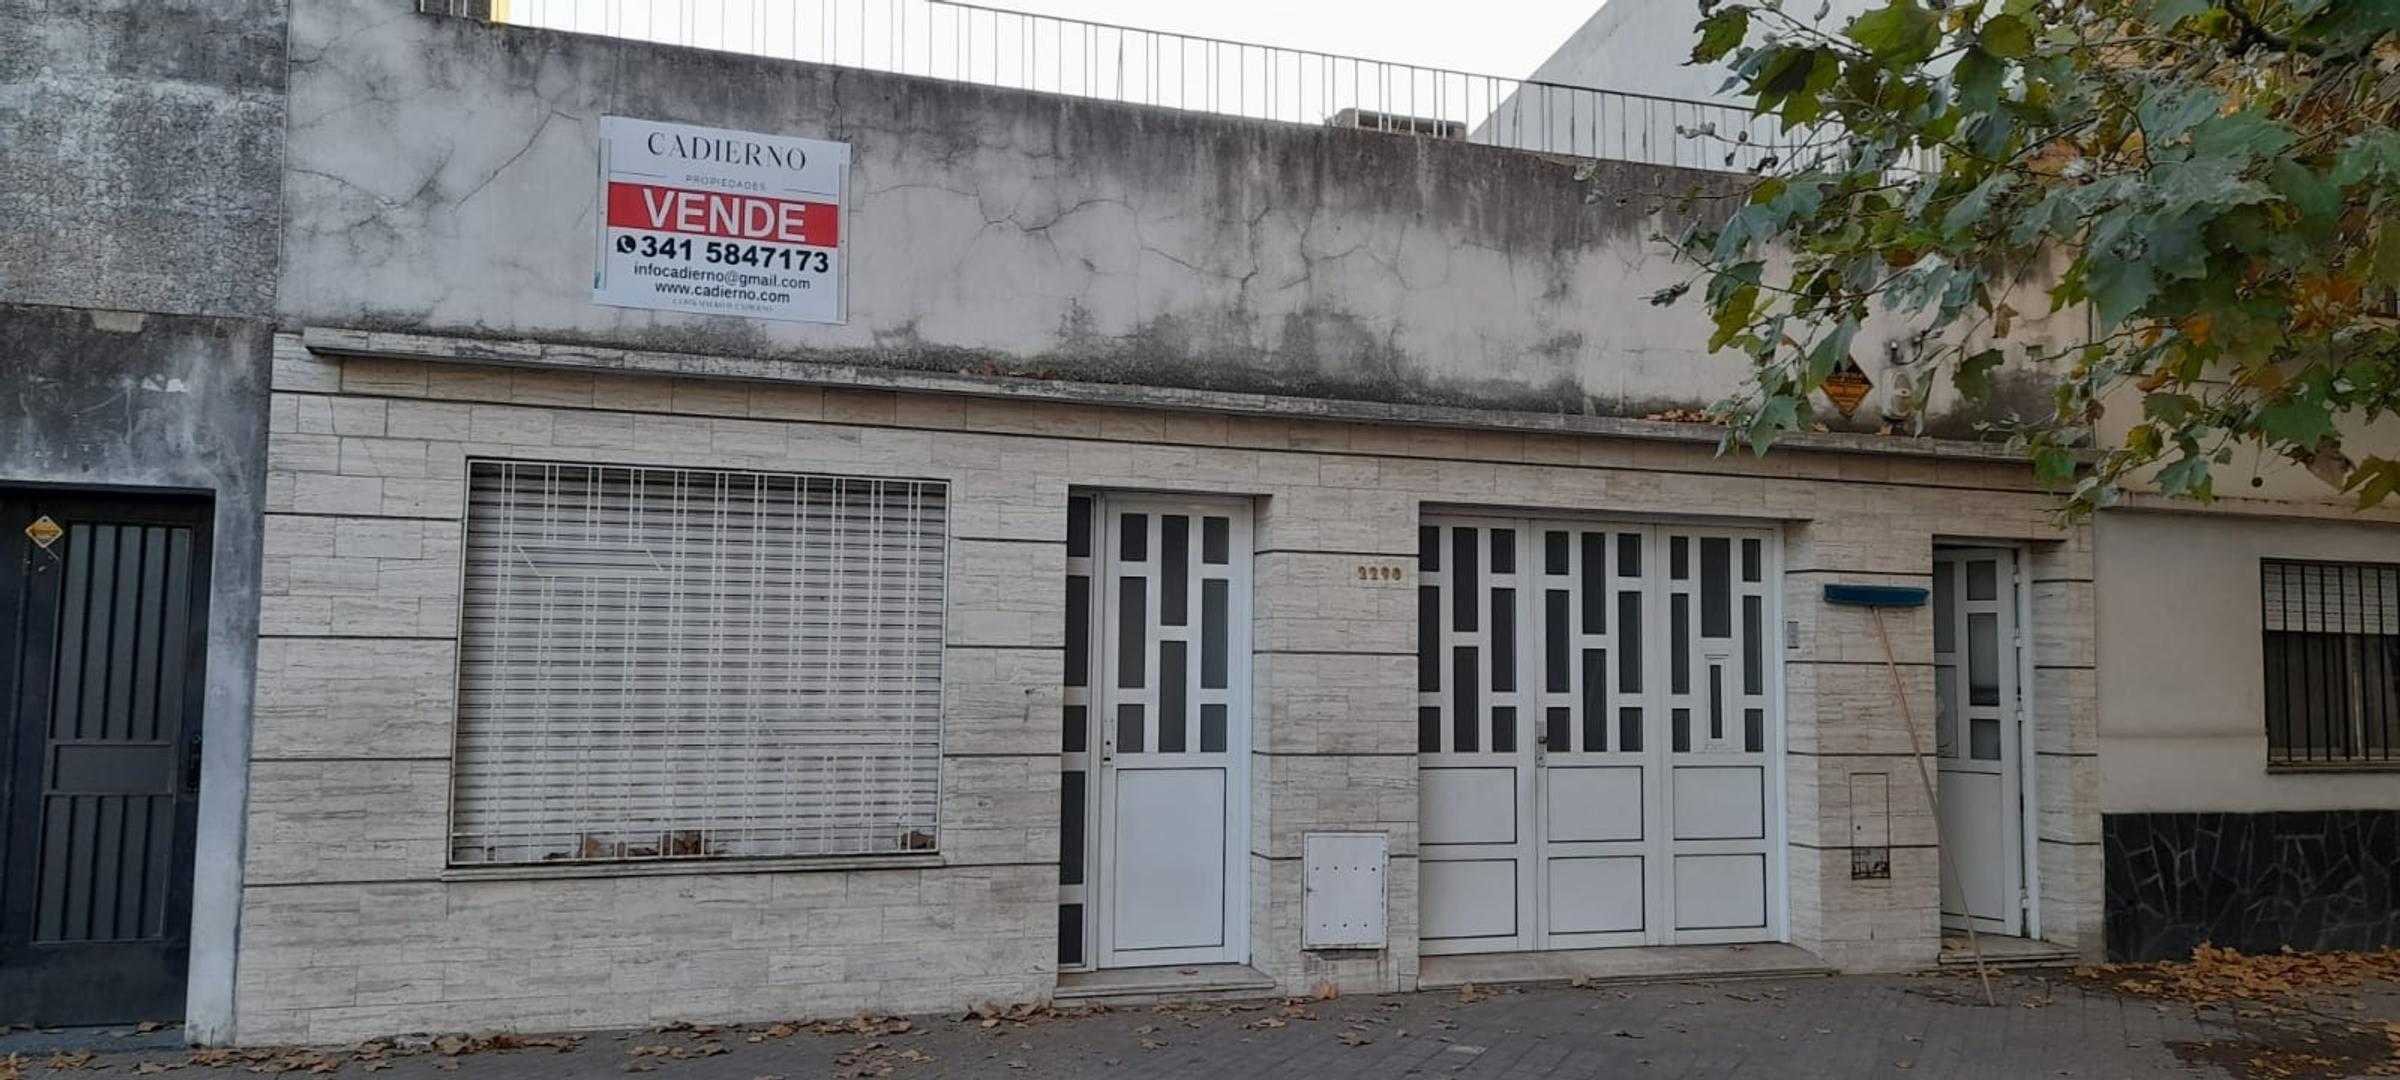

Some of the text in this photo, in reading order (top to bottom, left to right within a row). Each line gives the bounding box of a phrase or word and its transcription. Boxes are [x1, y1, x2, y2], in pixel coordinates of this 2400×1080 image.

[647, 131, 806, 171] CADIERNO
[685, 174, 767, 192] PROPIEDADES
[642, 188, 806, 242] VENDE
[640, 235, 829, 273] 341 5847173
[634, 263, 811, 289] infocadierno@gmail.com
[655, 281, 790, 303] www.cadierno.com
